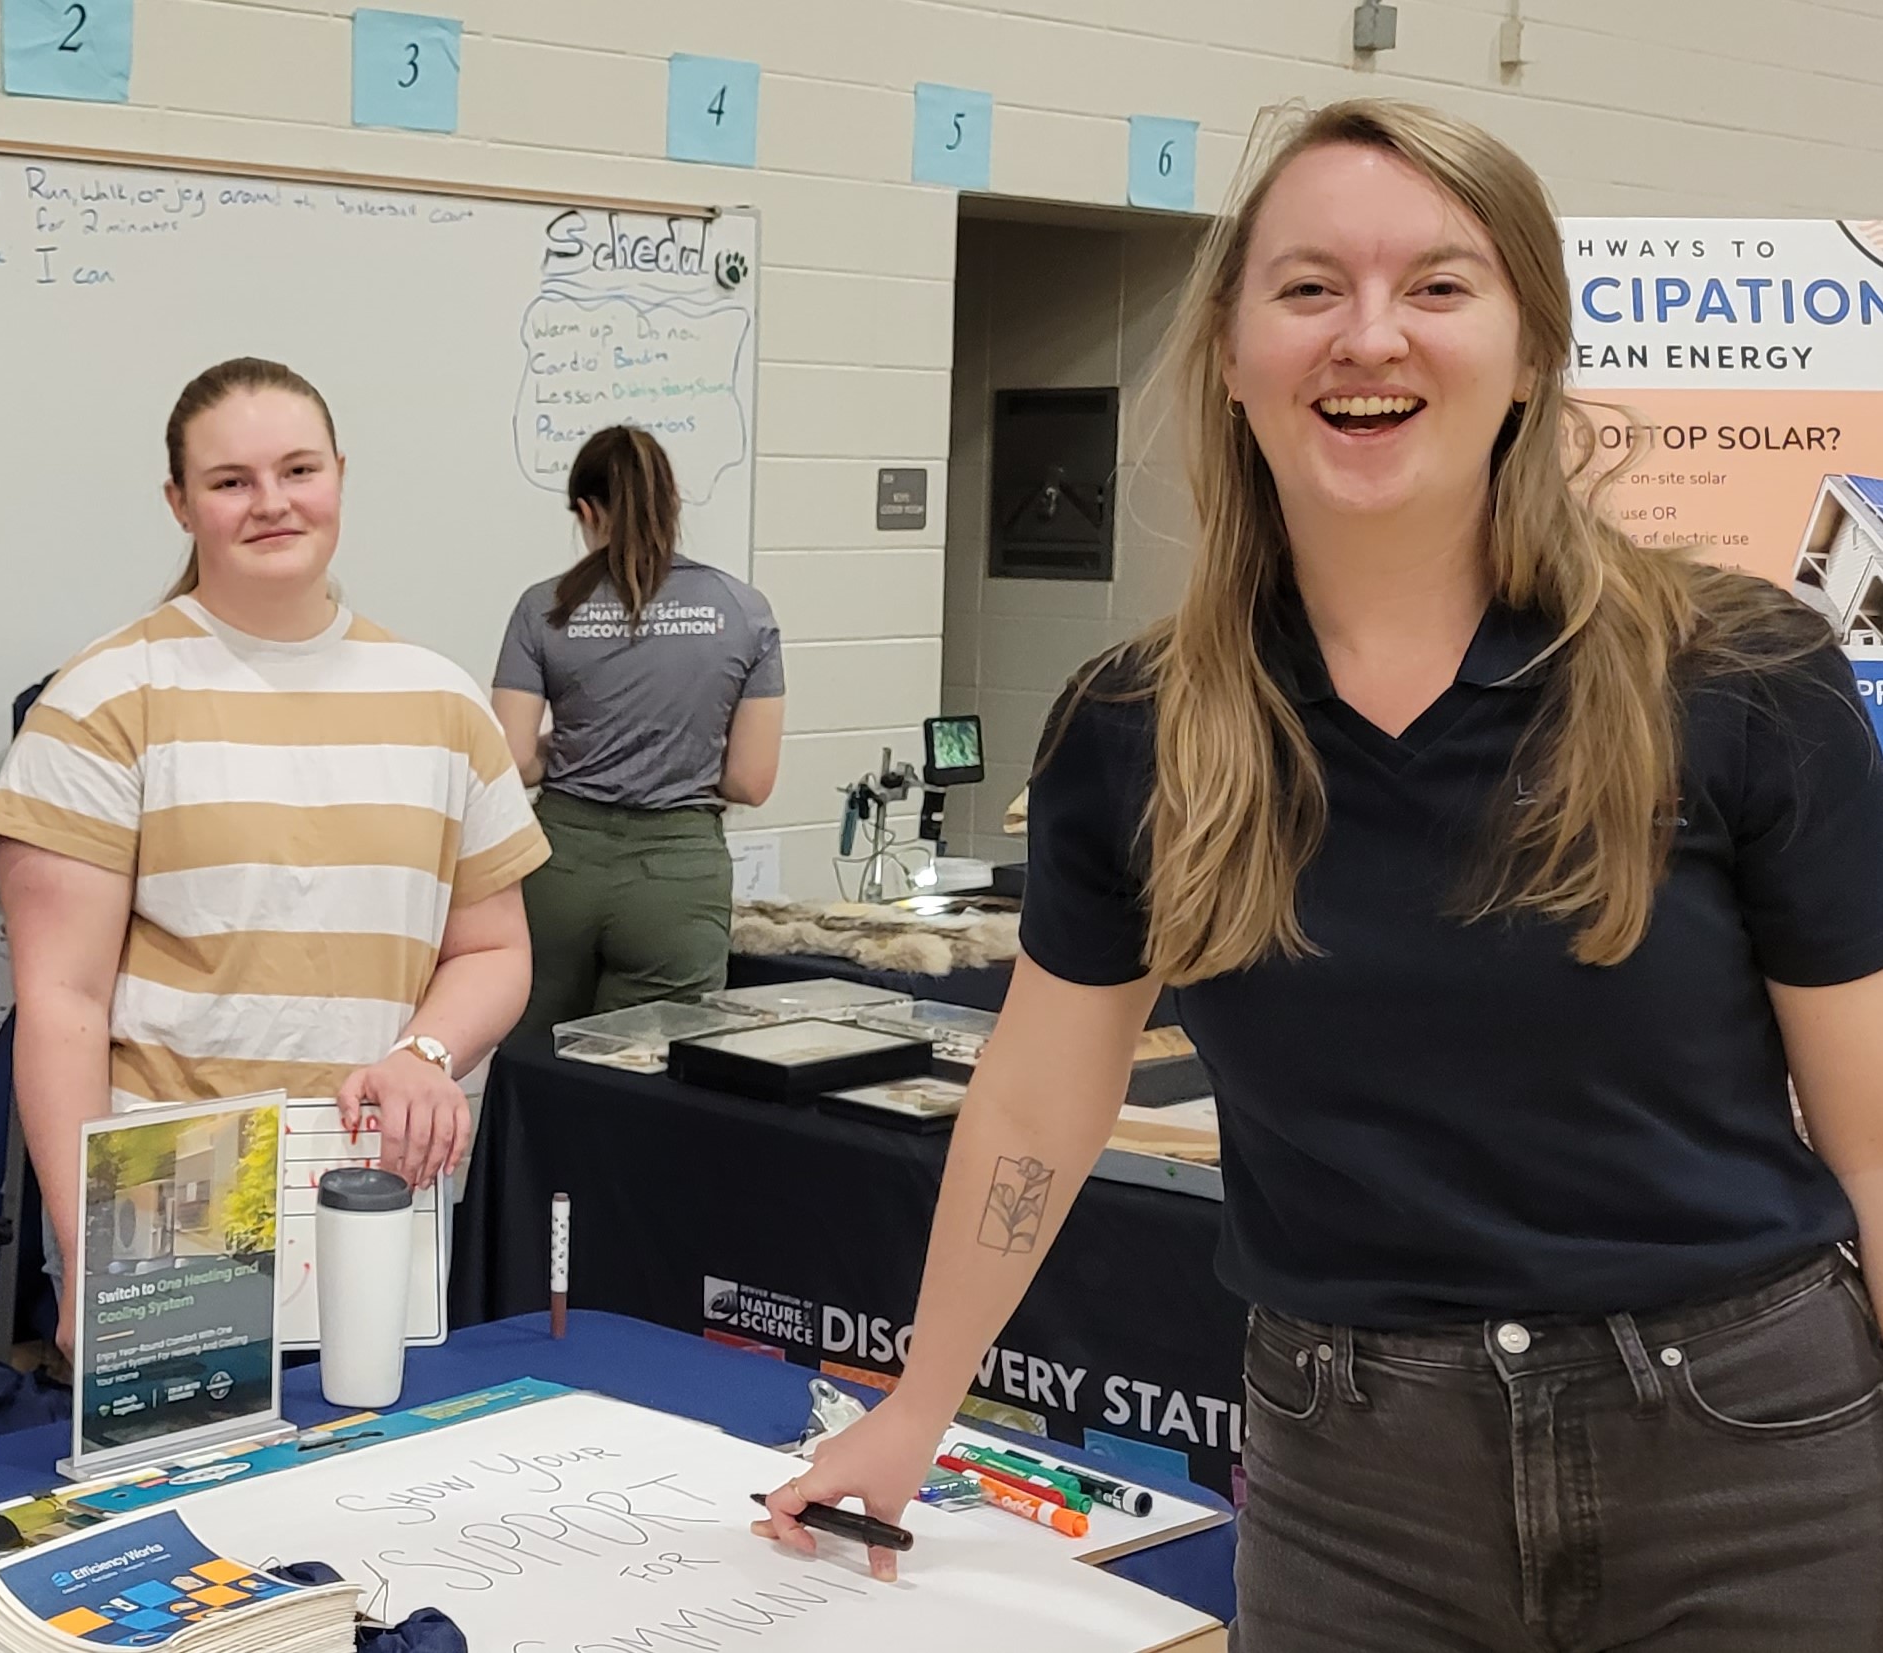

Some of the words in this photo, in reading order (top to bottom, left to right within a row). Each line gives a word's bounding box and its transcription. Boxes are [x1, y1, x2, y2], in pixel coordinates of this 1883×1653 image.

[58, 2, 87, 54] 2
[398, 43, 420, 89] 3
[707, 85, 726, 127] 4
[946, 112, 967, 151] 5
[1157, 142, 1174, 176] 6
[36, 206, 66, 233] for
[79, 208, 99, 235] 2
[1574, 239, 1705, 258] HWAYS
[1731, 240, 1776, 258] TO
[34, 247, 59, 284] I
[72, 267, 115, 284] can
[1581, 276, 1883, 326] CIPATION
[531, 313, 580, 339] Warm
[1576, 344, 1649, 369] EAN
[1666, 345, 1813, 370] ENERGY
[535, 381, 608, 405] Lesson
[535, 413, 594, 443] Pract
[1561, 425, 1707, 450] OOFTOP
[1718, 425, 1841, 451] SOLAR?
[1630, 471, 1685, 485] on-site
[1689, 471, 1728, 485] solar
[1619, 508, 1648, 521] use
[1652, 506, 1678, 521] OR
[1643, 531, 1660, 545] of
[1662, 531, 1718, 545] electric
[1721, 533, 1750, 546] use
[653, 621, 717, 636] STATION
[657, 606, 717, 620] SCIENCE
[97, 1284, 140, 1305] Switch
[141, 1282, 156, 1296] to
[156, 1278, 182, 1292] One
[184, 1266, 233, 1288] Heating
[234, 1260, 259, 1277] and
[97, 1304, 146, 1325] Cooling
[148, 1294, 195, 1317] System
[739, 1294, 804, 1326] NATURE
[216, 1326, 233, 1336] One
[739, 1311, 814, 1346] SCIENCE
[128, 1355, 157, 1369] System
[218, 1335, 249, 1349] Cooling
[822, 1304, 1087, 1413] DISCVERY
[1102, 1375, 1243, 1454] STATI
[335, 1475, 475, 1525] SHOW
[470, 1446, 621, 1493] YOUR
[379, 1473, 721, 1591] SUPPORT
[618, 1552, 721, 1584] FOR
[513, 1575, 868, 1653] MMUNI
